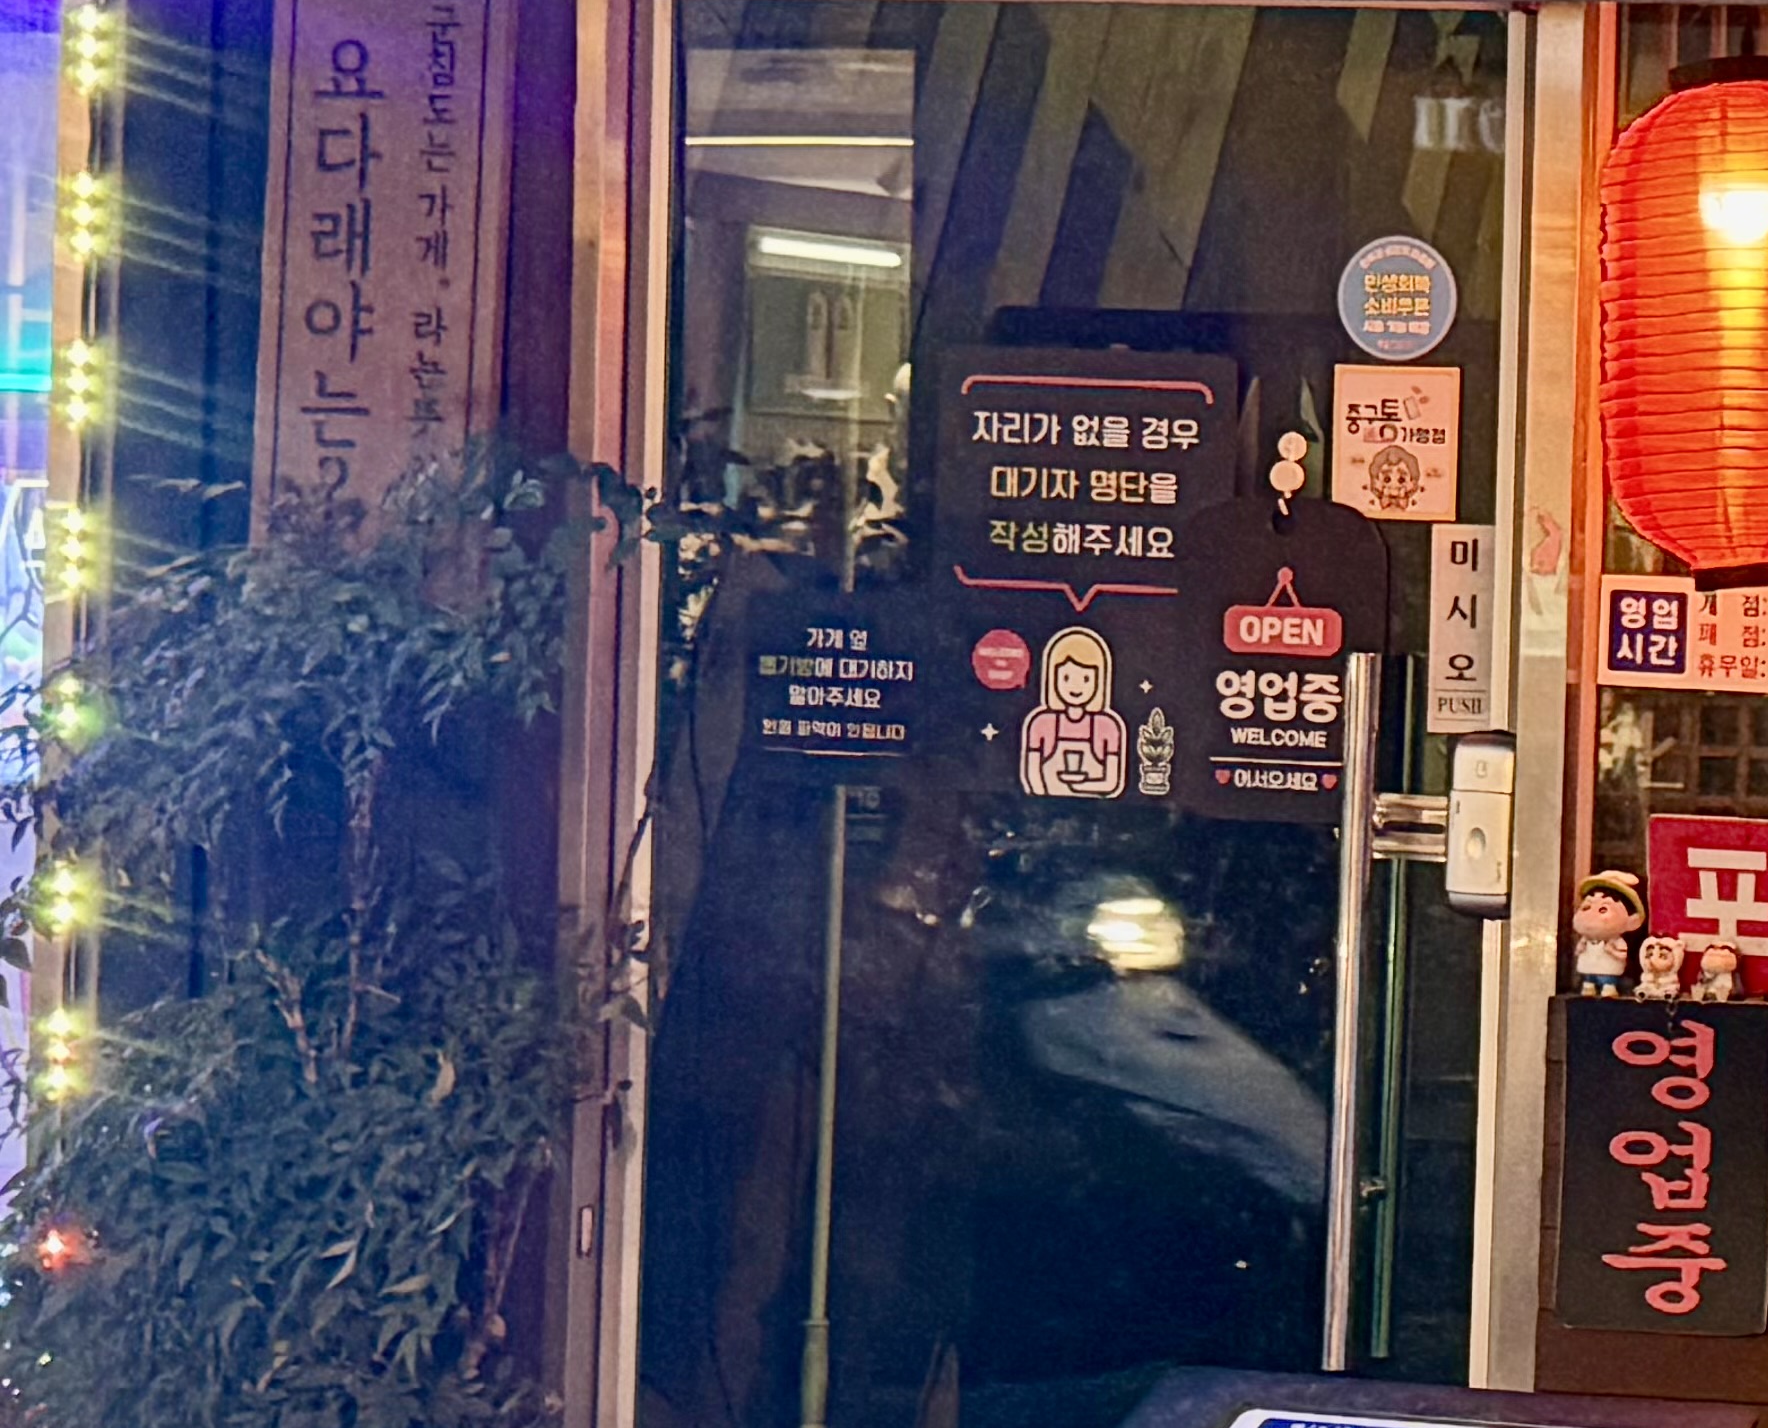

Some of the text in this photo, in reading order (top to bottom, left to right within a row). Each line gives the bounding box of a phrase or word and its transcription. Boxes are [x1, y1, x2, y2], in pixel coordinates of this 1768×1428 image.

[972, 411, 1199, 450] 자리가 없을 경우
[990, 466, 1178, 504] 대기자 명단을
[989, 520, 1174, 558] 작성해주세요
[1619, 596, 1678, 631] 영업
[806, 627, 868, 652] 가게 옆
[1239, 616, 1324, 646] OPEN
[1616, 633, 1678, 666] 시간
[839, 658, 913, 681] 대기하지
[789, 684, 881, 708] 말아주세요
[1216, 669, 1343, 723] 영업중
[1438, 699, 1482, 715] PUSH
[1230, 727, 1328, 749] WELCOME
[1234, 769, 1318, 792] 어서오세요
[1601, 1019, 1728, 1314] 영업중
